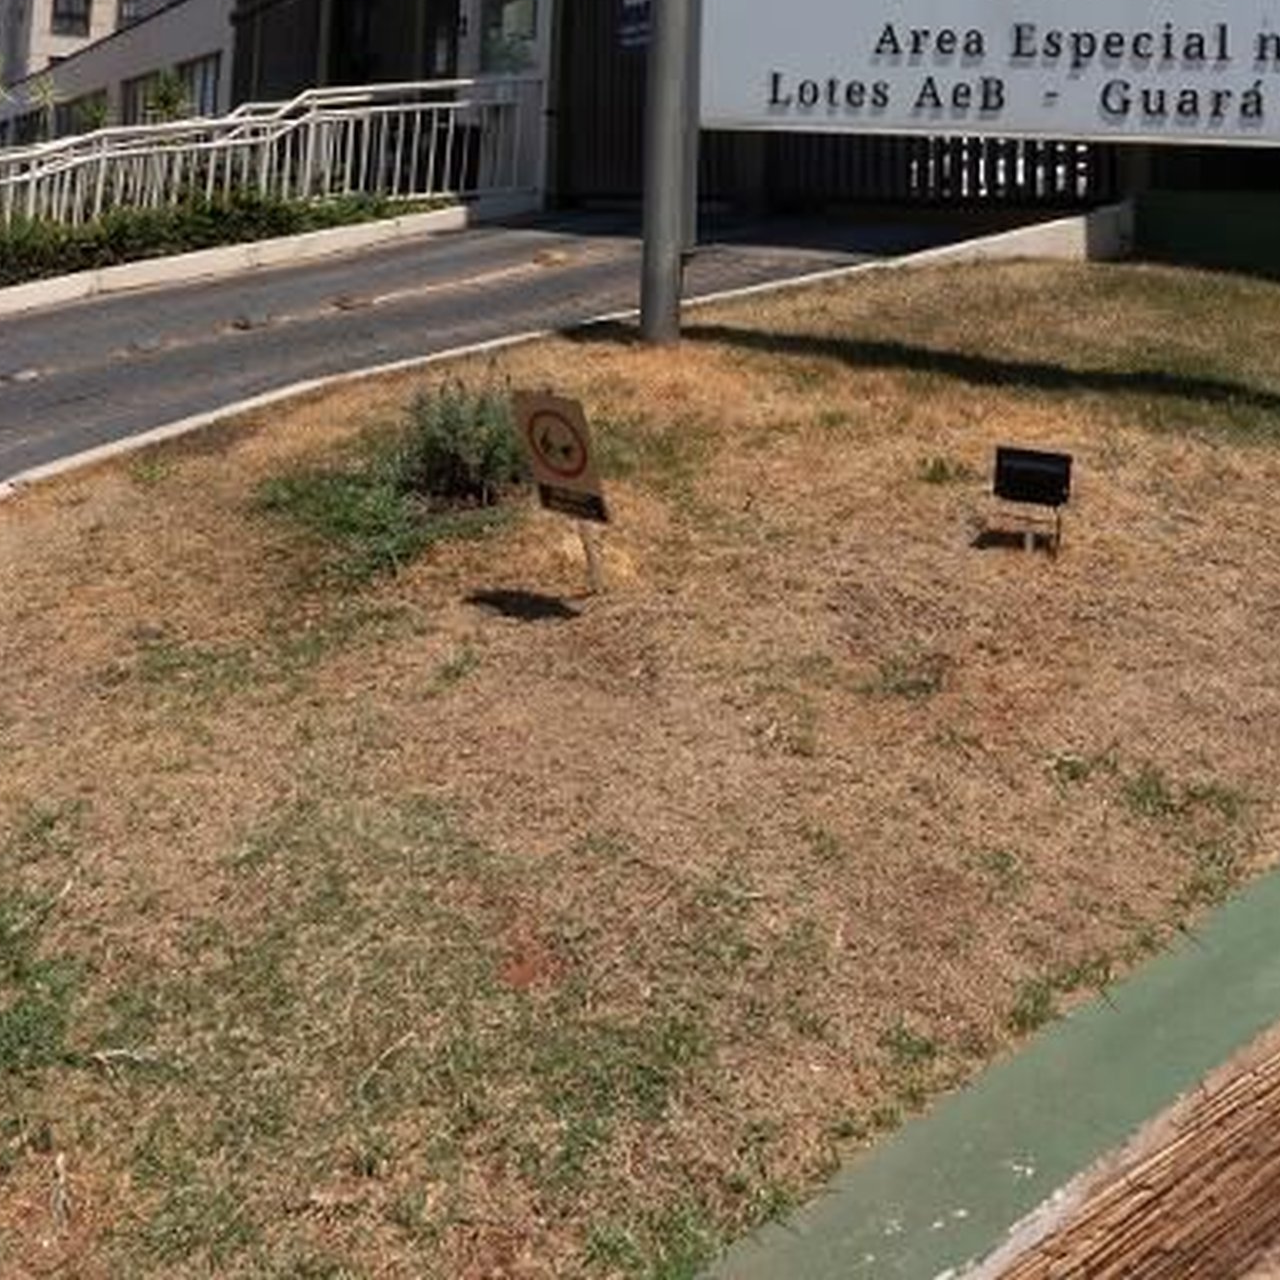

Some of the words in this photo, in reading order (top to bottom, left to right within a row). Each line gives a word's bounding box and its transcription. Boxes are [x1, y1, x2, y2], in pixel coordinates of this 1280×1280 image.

[873, 22, 986, 57] Area
[1010, 21, 1231, 70] Especial
[767, 71, 891, 110] Lotes
[913, 75, 1006, 113] AeB
[1099, 78, 1265, 120] Guará
